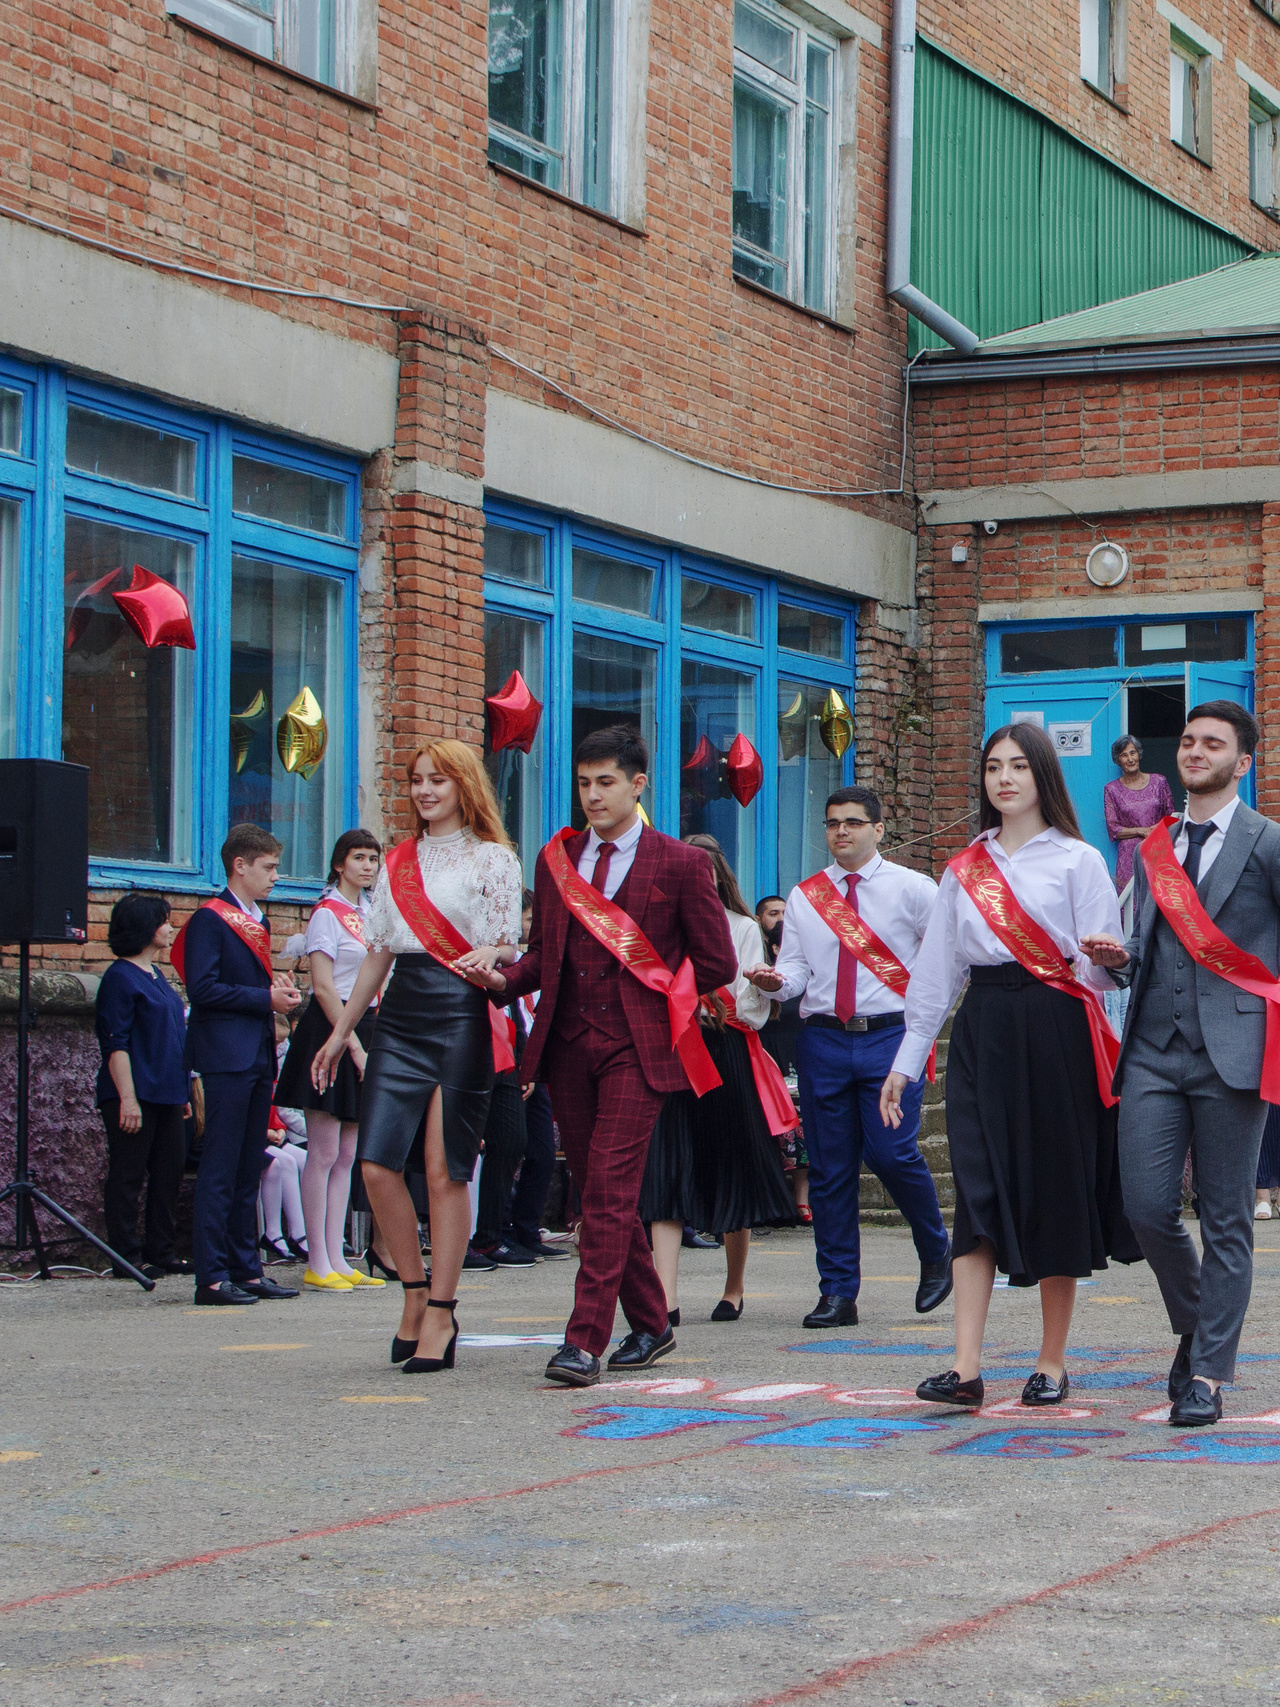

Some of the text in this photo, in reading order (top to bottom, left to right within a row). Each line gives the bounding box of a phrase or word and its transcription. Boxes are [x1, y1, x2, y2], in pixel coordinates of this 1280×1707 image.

[401, 879, 461, 958] Выпускник
[827, 900, 909, 988] Выпускник 2021
[978, 878, 1050, 963] Выпускник
[1159, 864, 1211, 948] Выпускник
[608, 931, 655, 967] 2021
